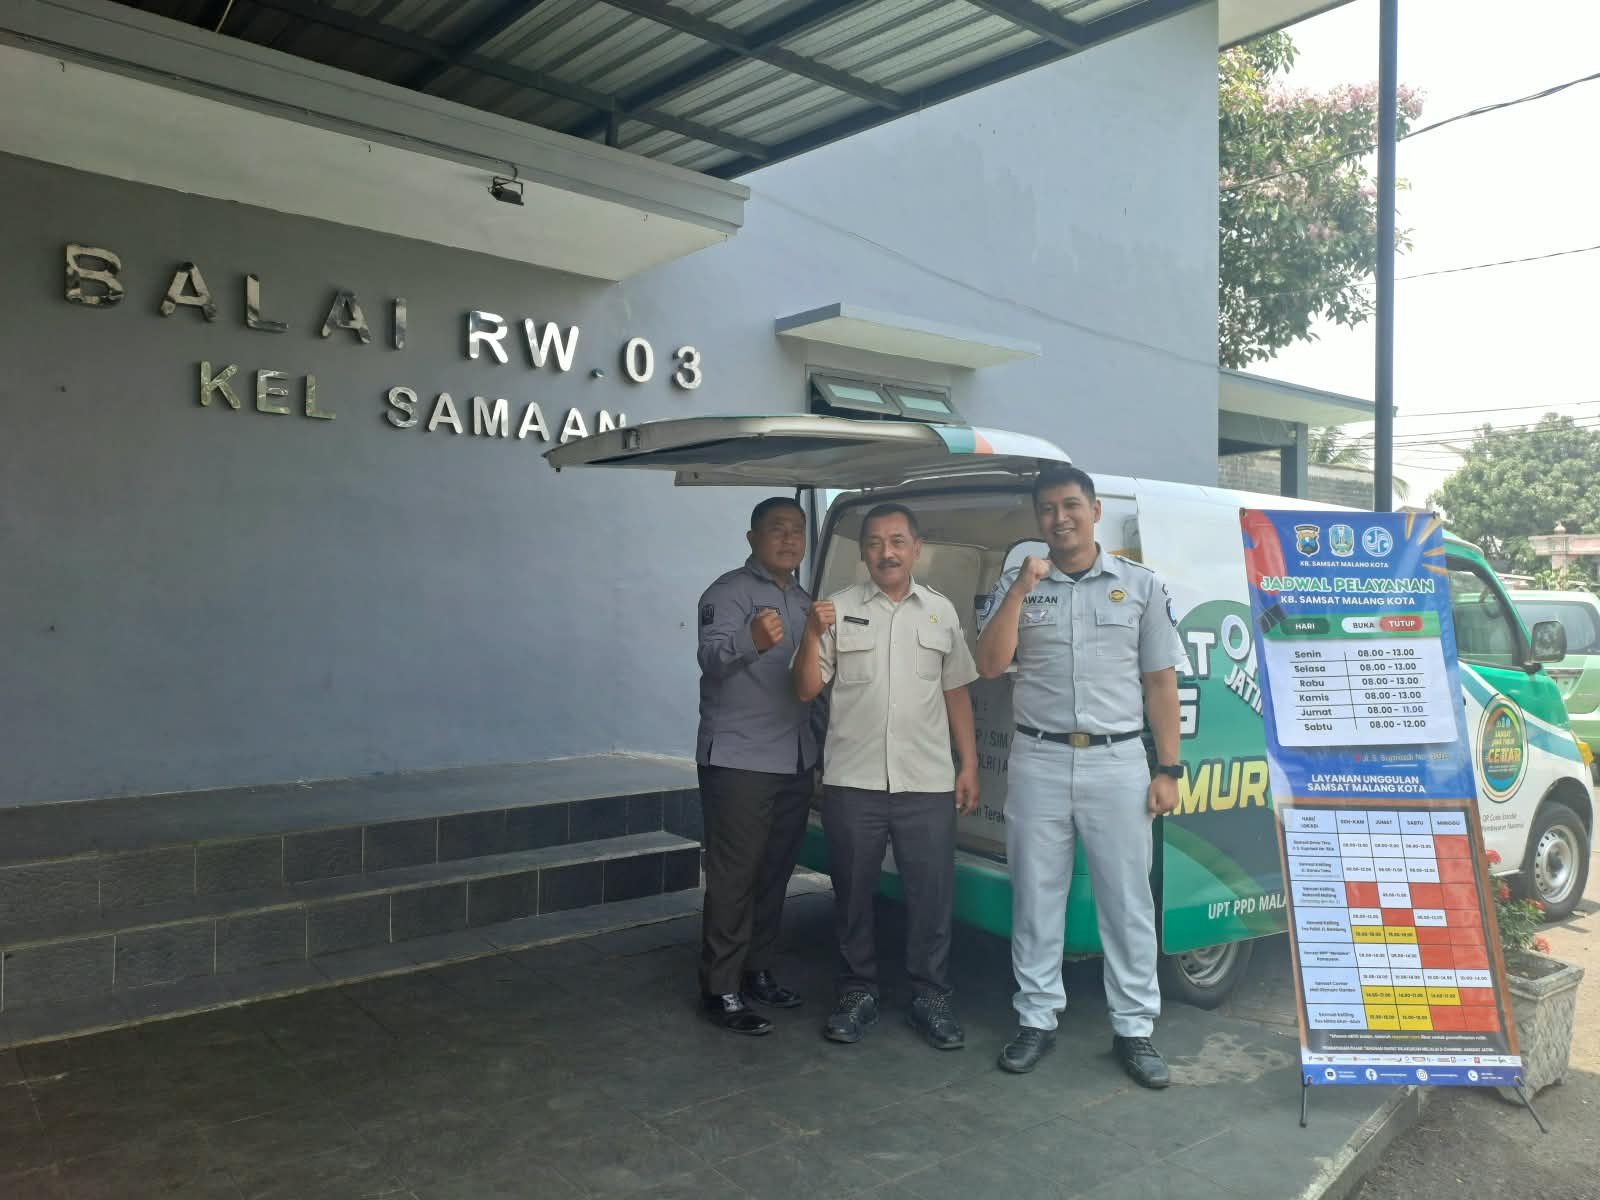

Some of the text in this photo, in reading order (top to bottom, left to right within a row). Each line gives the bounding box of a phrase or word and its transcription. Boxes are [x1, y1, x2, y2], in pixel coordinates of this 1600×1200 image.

[64, 243, 407, 351] BALAI
[199, 360, 627, 444] KEL SAMAAN
[1260, 576, 1436, 594] JADWAL PELAYANAN
[1022, 595, 1058, 604] AWZAN
[1280, 596, 1416, 606] KB. SAMSAT MALANG KOTA
[1295, 623, 1316, 631] HARI
[1389, 620, 1416, 628] TUTUP
[1294, 650, 1322, 659] Senin
[1357, 649, 1384, 657] 08.00
[1392, 648, 1415, 656] 13.00
[1294, 664, 1326, 673] Selasa
[1360, 663, 1386, 671] 08.00
[1394, 662, 1417, 670] 13.00
[1299, 679, 1325, 687] Rabu
[1362, 678, 1388, 686] 08.00
[1396, 677, 1419, 685] 13.00
[1224, 664, 1263, 716] JATI
[1299, 694, 1330, 702] Kamis
[1364, 692, 1391, 700] 08.00
[1398, 691, 1422, 699] 13.00
[1301, 708, 1333, 717] Jumat
[1367, 706, 1393, 714] 08.00
[1402, 705, 1424, 713] 11.00
[1304, 722, 1333, 731] Sabtu
[1369, 720, 1395, 729] 08.00
[1403, 719, 1426, 728] 12.00
[1311, 774, 1419, 784] LAYANAN UNGGULAN
[1164, 760, 1269, 817] MUR
[1307, 783, 1426, 793] SAMSAT MALANG KOTA
[1208, 894, 1288, 919] UPT PPD MALA
